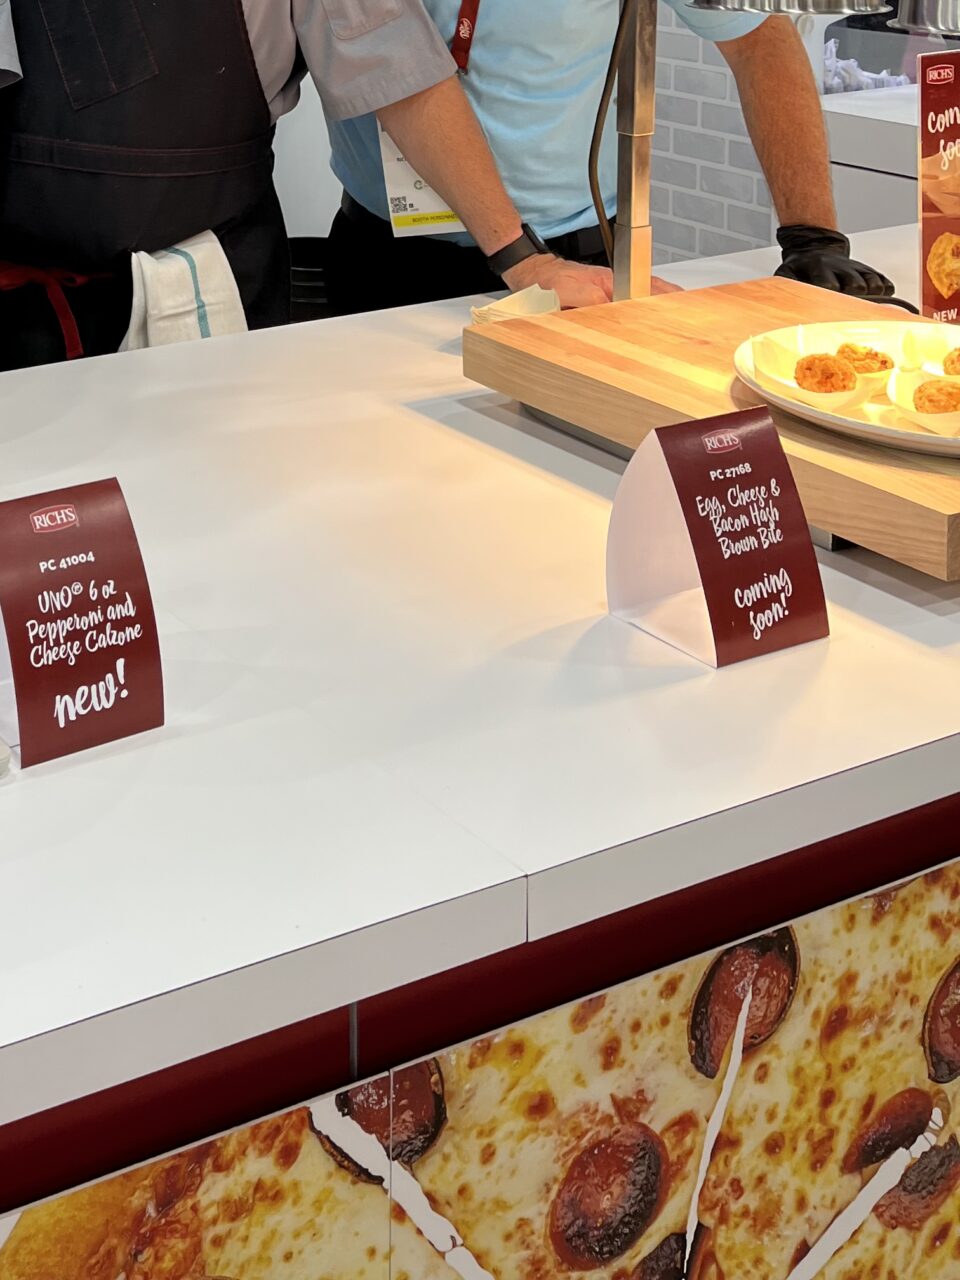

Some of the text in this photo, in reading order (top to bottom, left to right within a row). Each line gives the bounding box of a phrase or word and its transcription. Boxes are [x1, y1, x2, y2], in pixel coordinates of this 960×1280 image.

[933, 308, 958, 322] NEW
[709, 462, 752, 481] PC 27168
[727, 482, 768, 508] Cheese
[770, 478, 781, 497] &
[711, 500, 780, 537] Bacon Hash
[718, 523, 784, 559] Brown Bite
[39, 551, 96, 573] PC 41004
[89, 581, 98, 601] 6
[101, 580, 118, 600] oz
[734, 568, 792, 608] Coming
[26, 593, 137, 646] Pepperoni and
[749, 593, 789, 640] soon!
[29, 623, 144, 668] Cheese Calzone
[54, 657, 129, 729] new!
